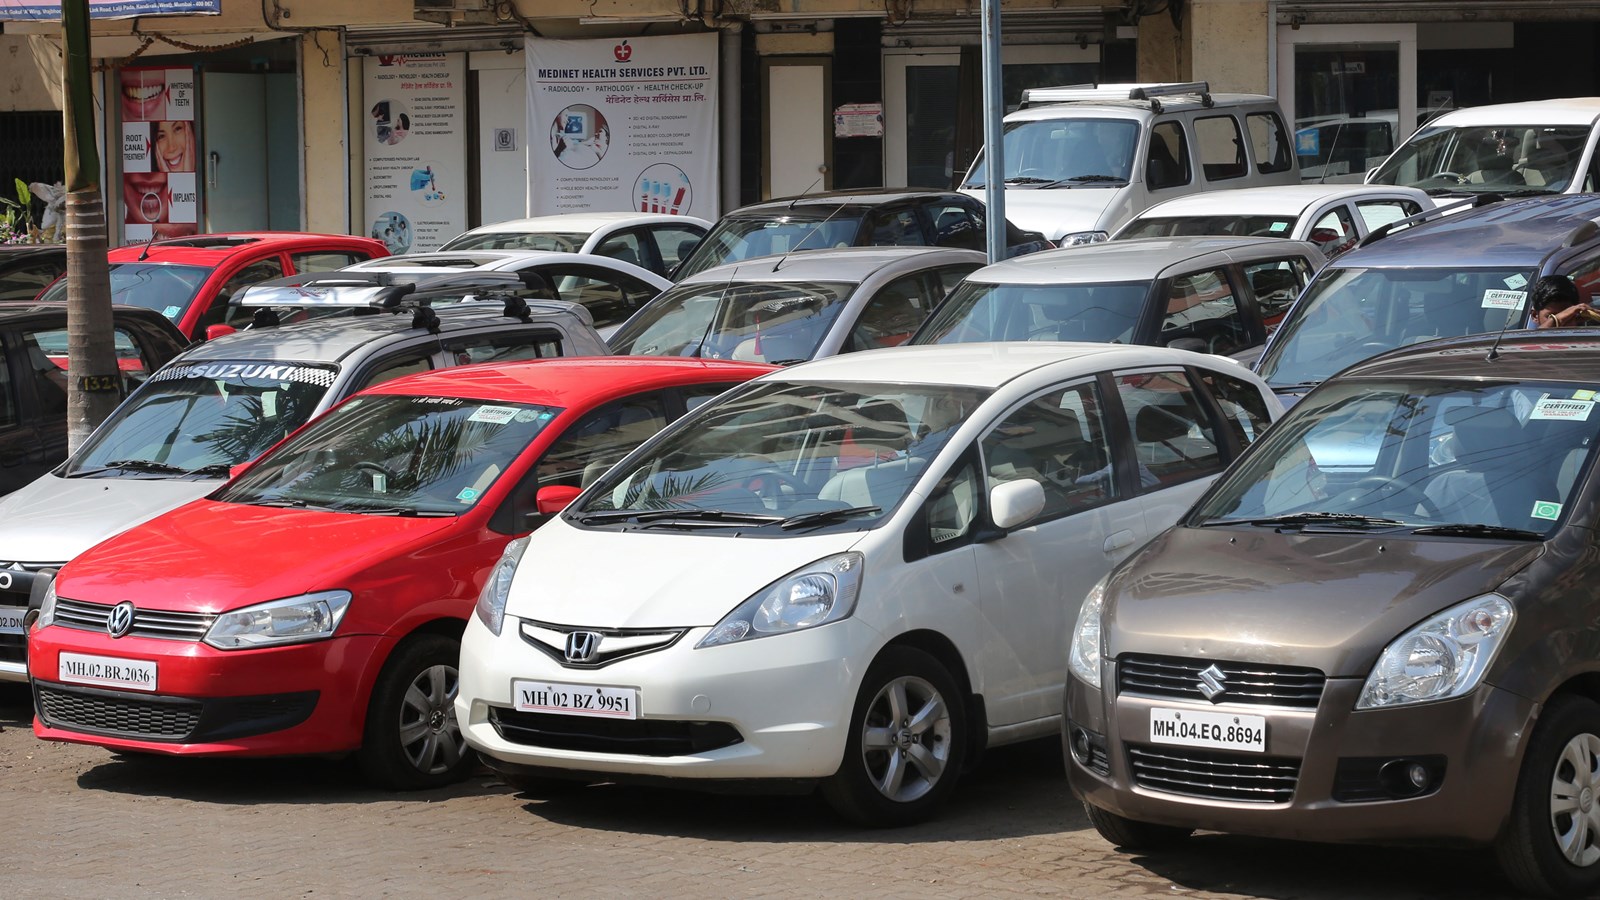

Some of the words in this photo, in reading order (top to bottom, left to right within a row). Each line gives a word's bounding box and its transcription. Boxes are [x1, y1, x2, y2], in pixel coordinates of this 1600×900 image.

[538, 68, 580, 79] MEDINET
[582, 68, 616, 79] HEALTH
[619, 67, 664, 78] SERVICES
[667, 66, 686, 77] PVT.
[689, 66, 708, 76] LTD.
[170, 82, 193, 90] WHITENING
[595, 84, 634, 92] PATHOLOGY
[670, 82, 704, 90] CHECK-UP
[178, 90, 185, 98] OF
[174, 98, 190, 107] TEETH
[125, 134, 142, 142] ROOT
[124, 143, 144, 151] CANAL
[173, 192, 195, 202] IMPLANTS
[1490, 292, 1523, 300] CERTIFIED
[187, 364, 298, 380] SUZUKI
[481, 408, 513, 416] CERTIFIED
[65, 660, 150, 683] MH.02.BR.2036
[522, 689, 548, 706] MH
[552, 692, 568, 707] 02
[573, 693, 594, 710] BZ
[598, 695, 630, 712] 9951
[1153, 719, 1262, 745] MH.04.EQ.8694
